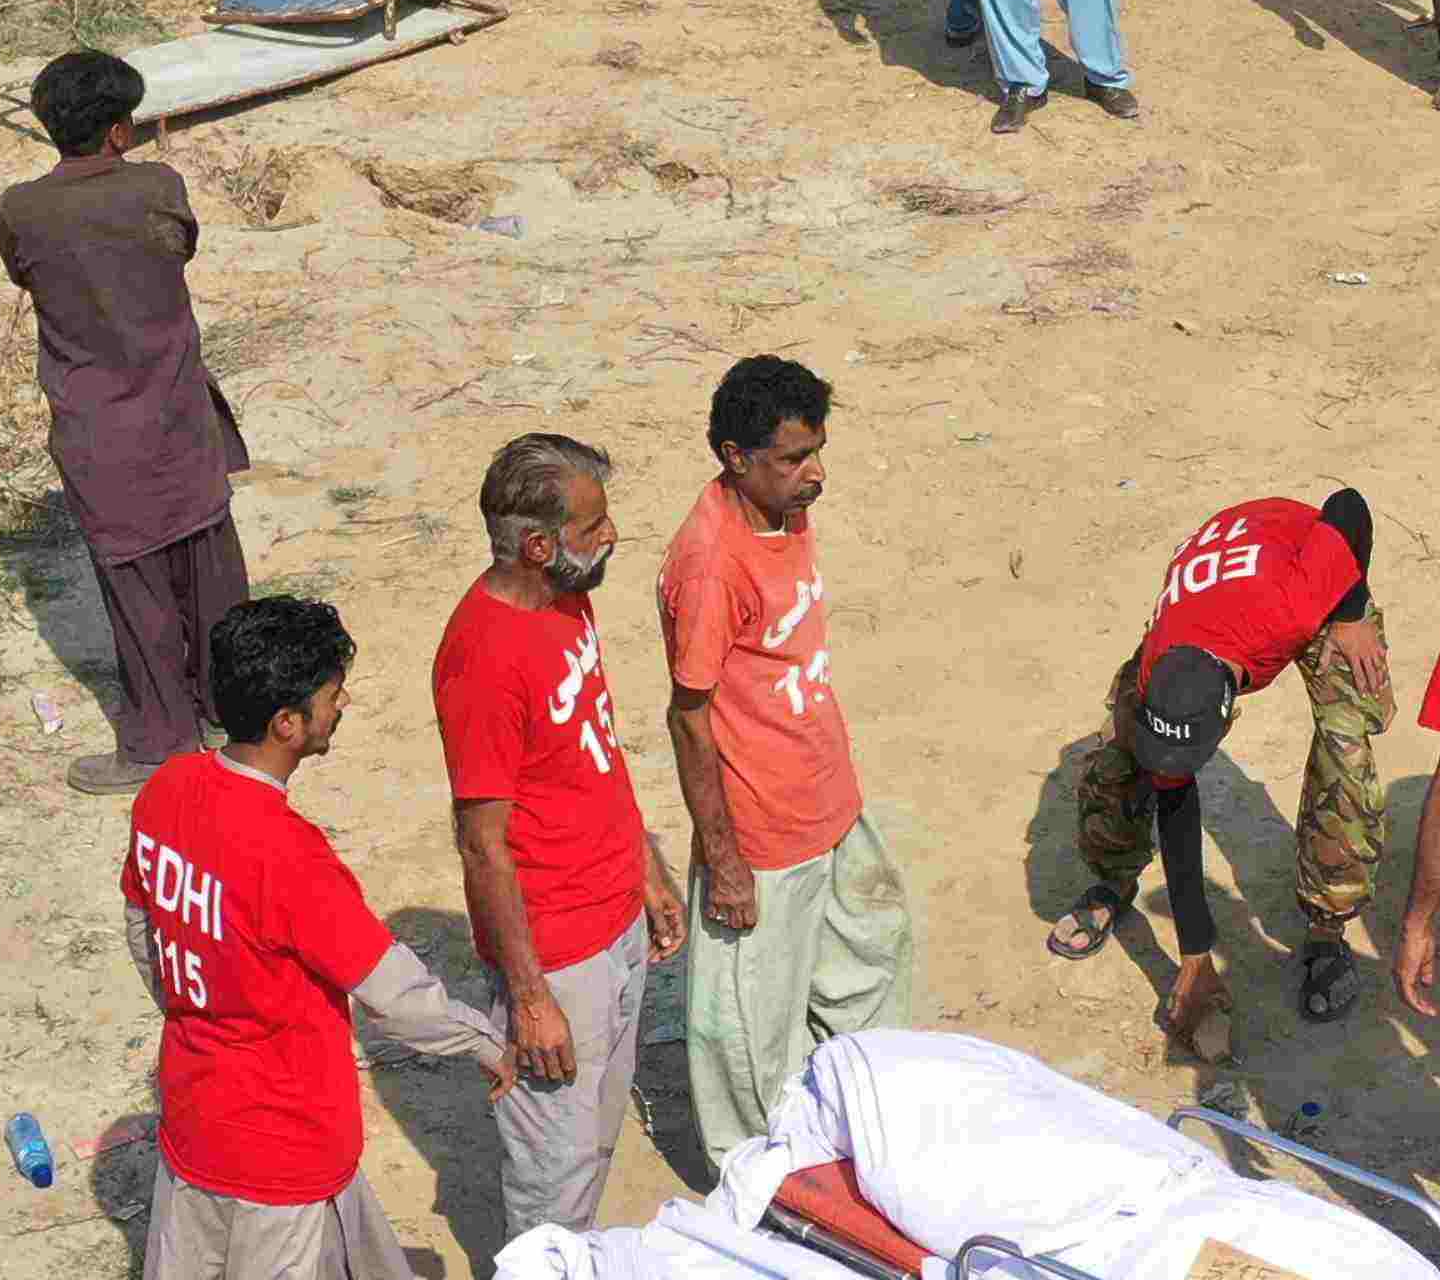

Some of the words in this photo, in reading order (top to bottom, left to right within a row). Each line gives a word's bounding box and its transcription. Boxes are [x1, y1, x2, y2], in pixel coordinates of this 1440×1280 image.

[1150, 543, 1264, 623] EDH
[135, 830, 225, 942] EDHI
[153, 927, 208, 1009] 115
